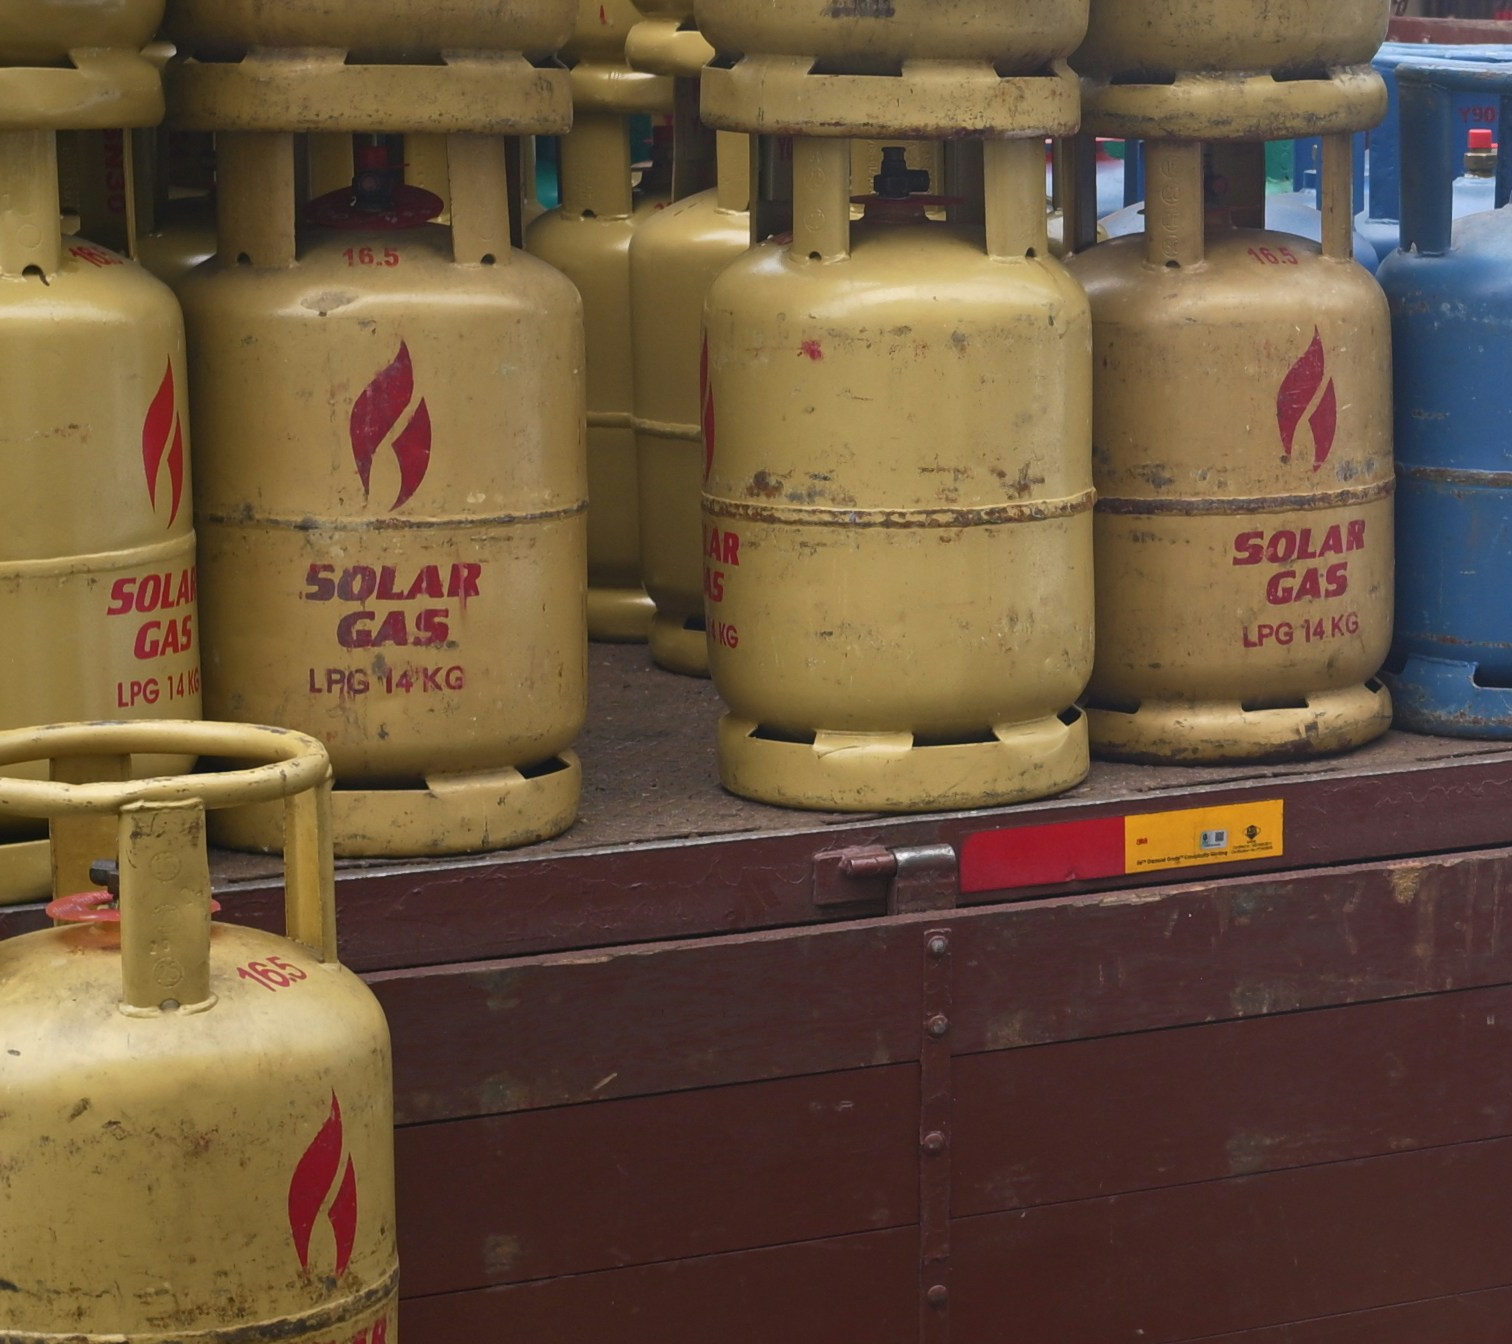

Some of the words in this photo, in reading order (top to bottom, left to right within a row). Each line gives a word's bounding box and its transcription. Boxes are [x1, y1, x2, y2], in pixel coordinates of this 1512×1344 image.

[342, 246, 400, 269] 16.5
[1247, 243, 1297, 269] 16.5
[1232, 519, 1366, 567] SOLAR
[106, 564, 197, 616] SOLAR
[303, 562, 482, 602] SOLAR
[1266, 561, 1349, 606] GAS
[133, 614, 192, 660] GAS
[335, 608, 450, 650] GAS
[1242, 622, 1294, 649] LPG
[1303, 617, 1326, 643] 14
[1331, 610, 1360, 639] KG
[117, 677, 160, 709] LPG
[167, 671, 185, 701] 14
[308, 667, 371, 695] LPG
[384, 666, 414, 694] 14
[422, 664, 466, 692] KG
[236, 955, 308, 994] 16.5
